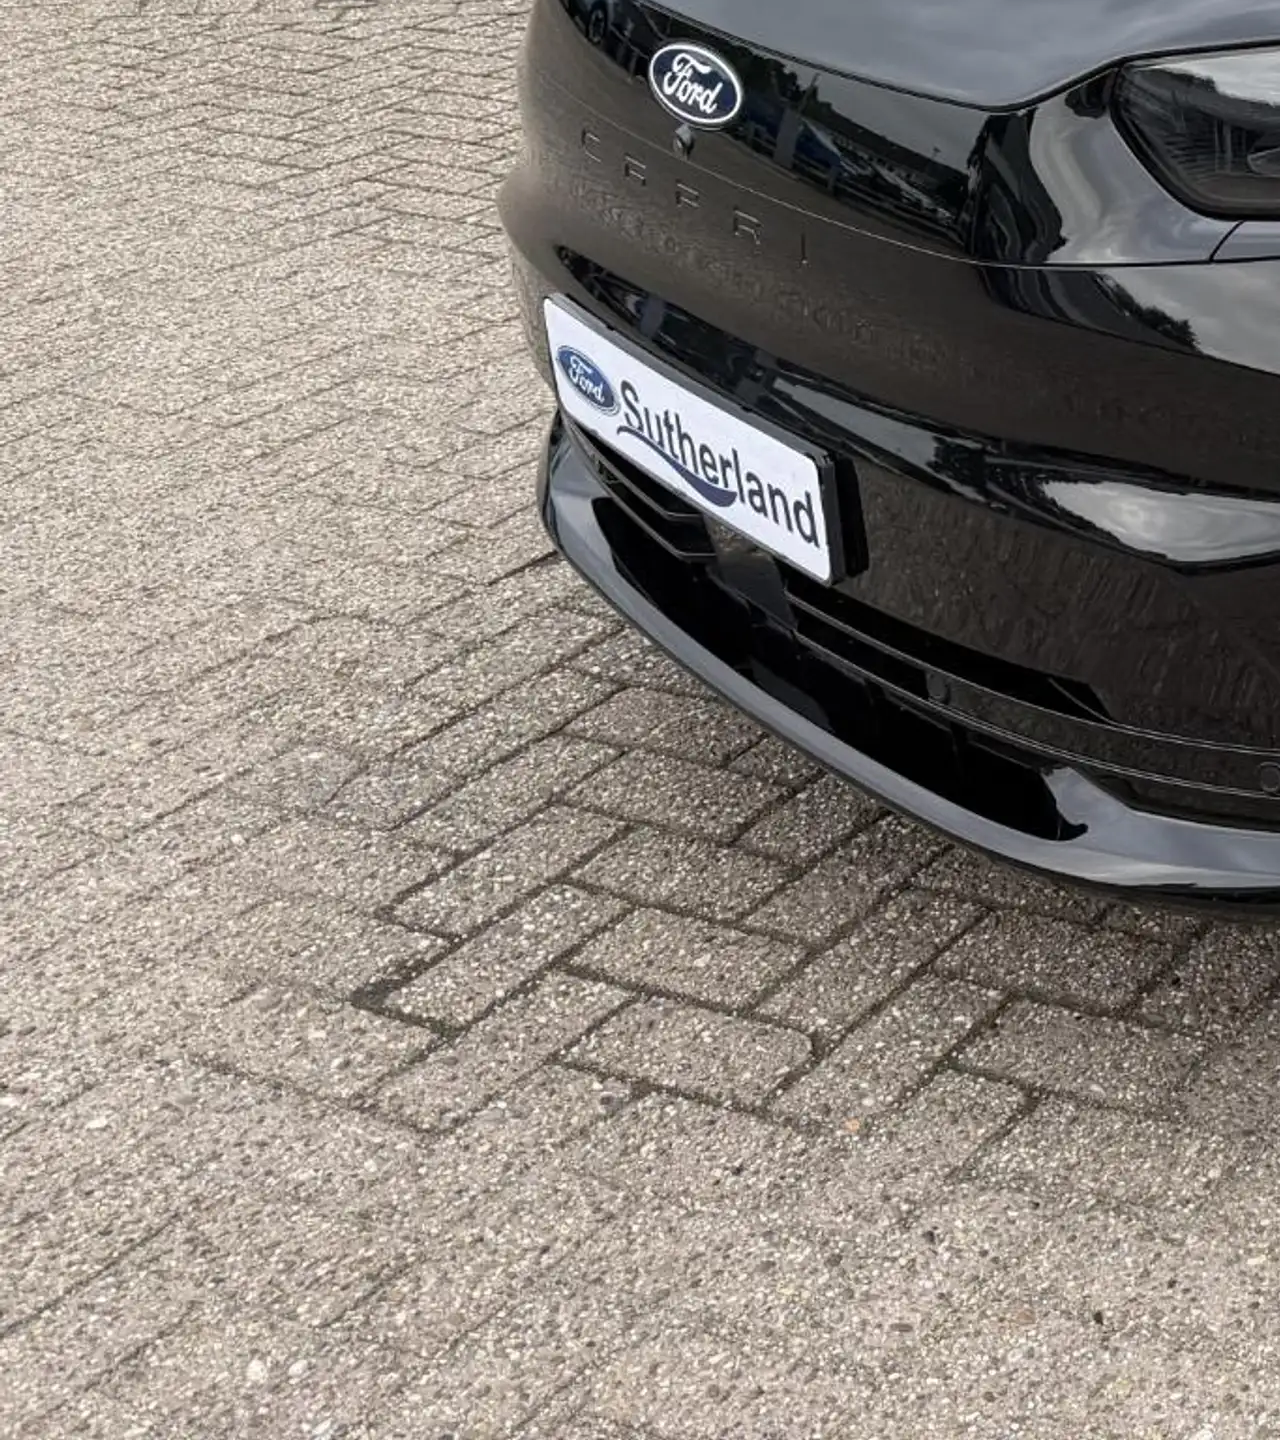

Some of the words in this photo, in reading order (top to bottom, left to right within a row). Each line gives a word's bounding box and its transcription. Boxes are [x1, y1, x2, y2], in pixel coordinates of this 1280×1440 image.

[662, 52, 724, 114] Ford
[581, 126, 808, 264] CAPRI
[620, 379, 820, 549] Sutherland
